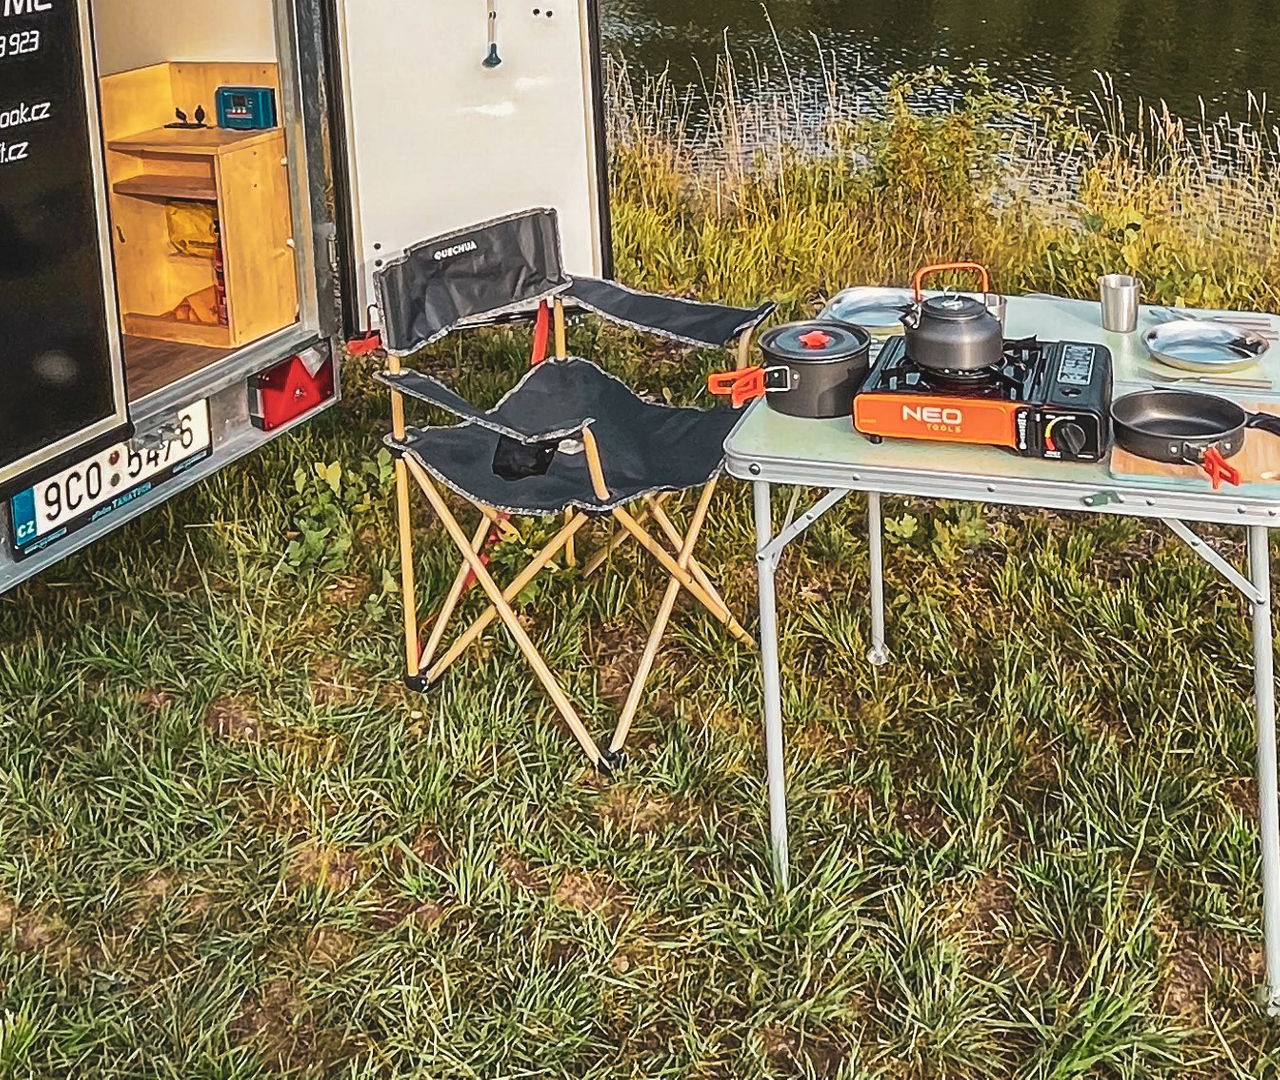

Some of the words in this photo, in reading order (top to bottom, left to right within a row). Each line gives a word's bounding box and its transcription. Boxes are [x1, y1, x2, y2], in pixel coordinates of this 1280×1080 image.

[9, 30, 40, 56] 923
[433, 239, 479, 261] QUECHUA
[902, 405, 963, 425] NEO
[926, 423, 962, 433] TOOLS
[17, 520, 35, 539] CZ
